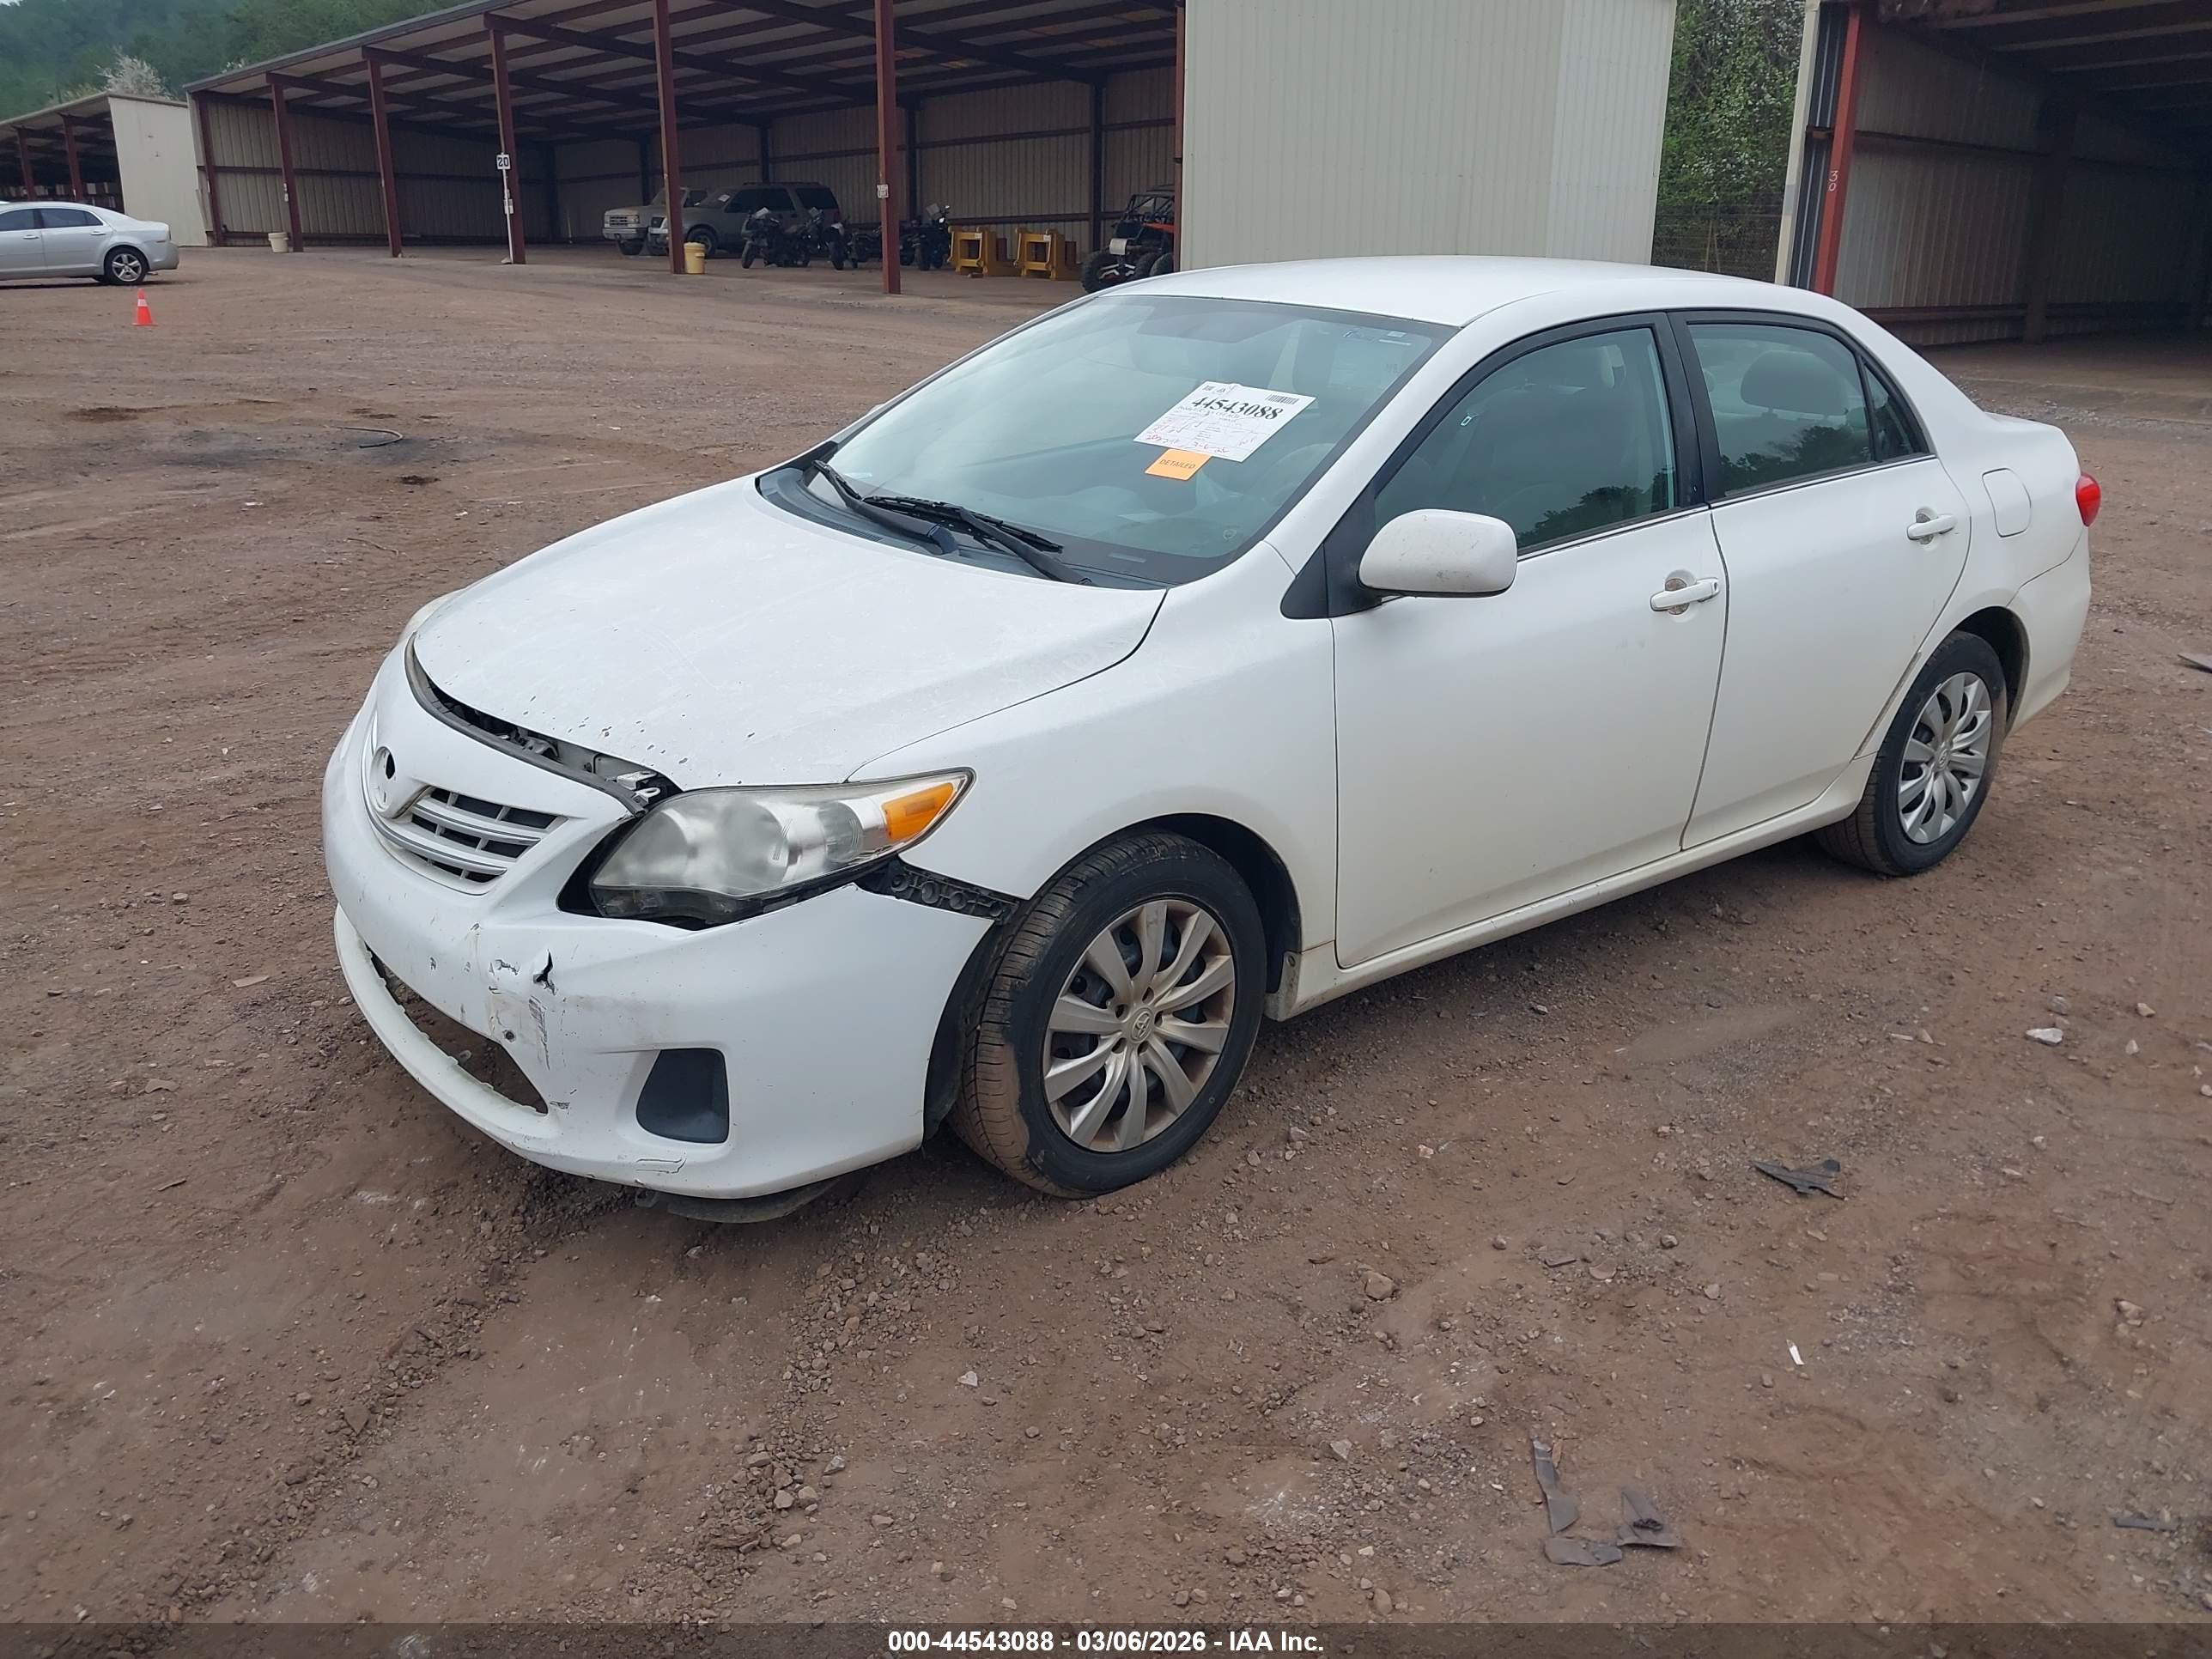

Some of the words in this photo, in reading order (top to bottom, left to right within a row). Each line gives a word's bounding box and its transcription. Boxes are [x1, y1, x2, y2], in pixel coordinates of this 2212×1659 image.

[497, 156, 509, 167] 20
[1828, 170, 1838, 191] 30
[1191, 396, 1284, 420] 44543088
[1159, 459, 1196, 470] DETAILED
